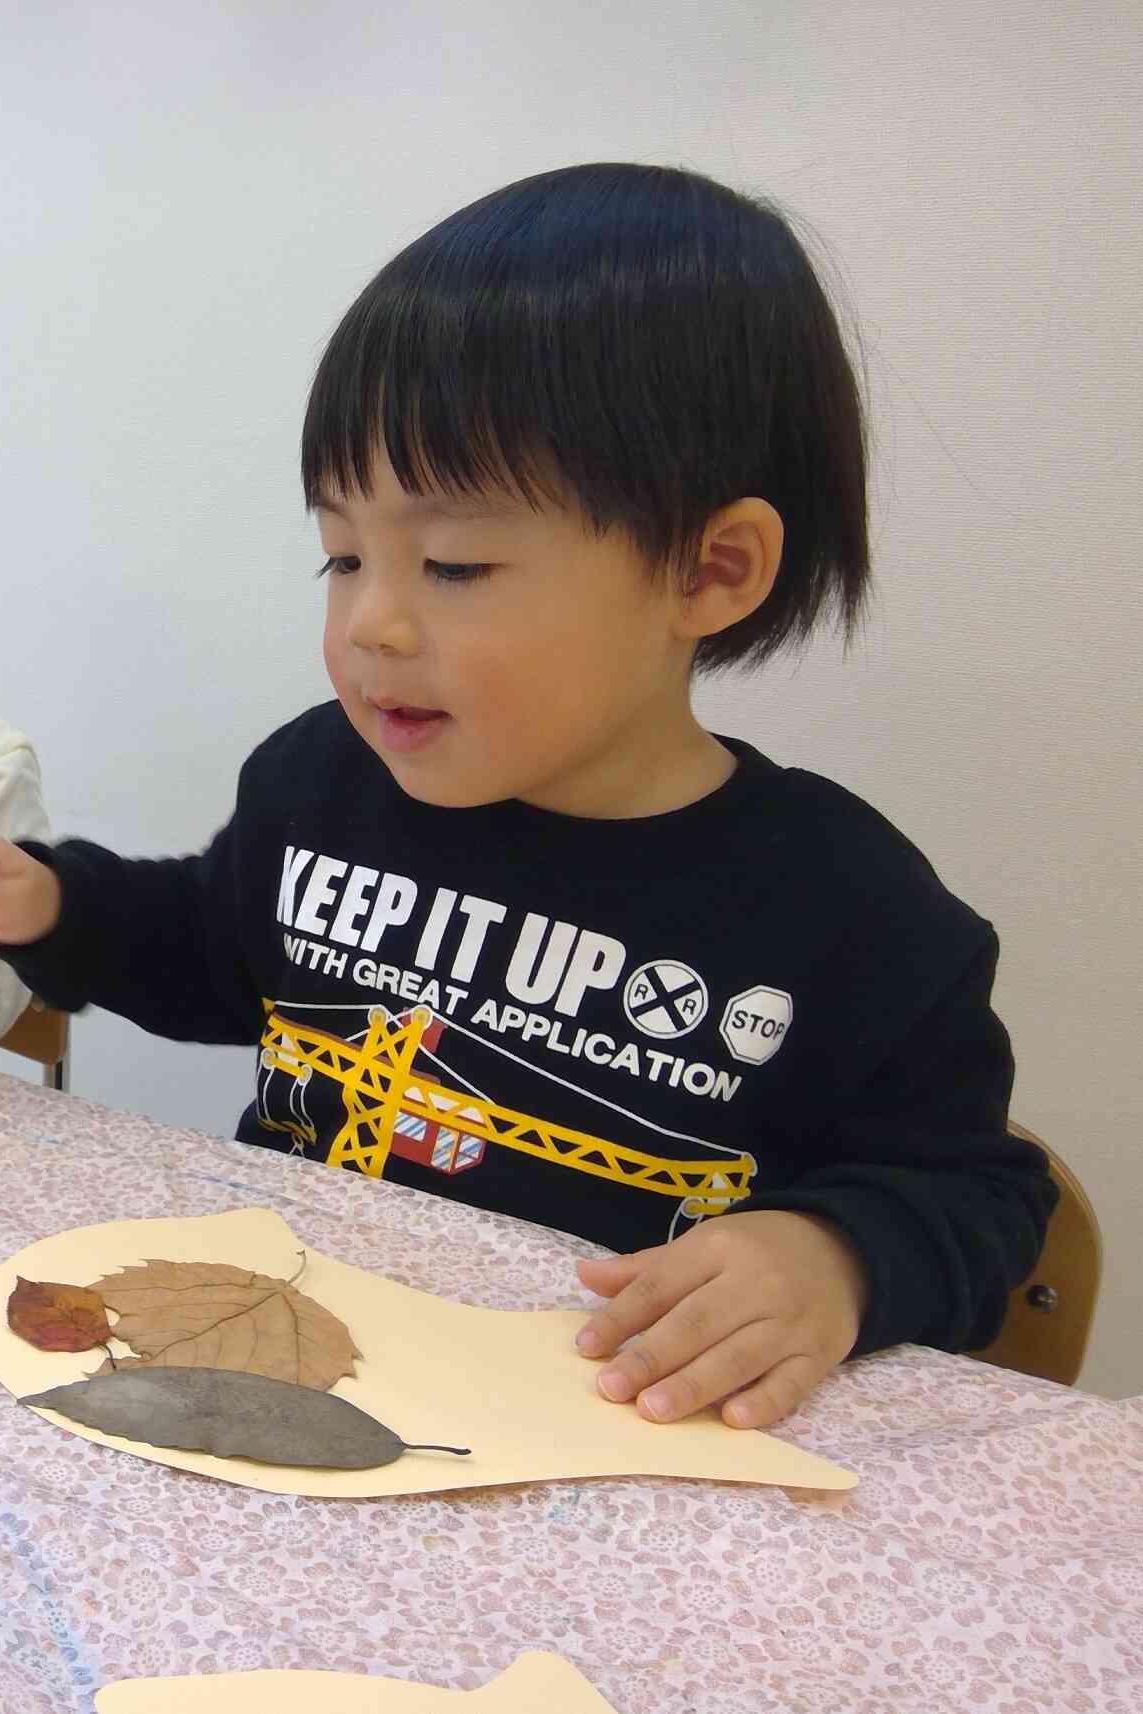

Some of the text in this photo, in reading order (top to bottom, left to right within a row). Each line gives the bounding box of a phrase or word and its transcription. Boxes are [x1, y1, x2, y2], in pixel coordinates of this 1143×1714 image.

[277, 846, 626, 1017] KEEP IT UP
[634, 983, 650, 1001] R
[681, 997, 697, 1015] R
[283, 932, 743, 1101] WITH GREAT APPLICATION
[731, 1008, 785, 1041] STOP
